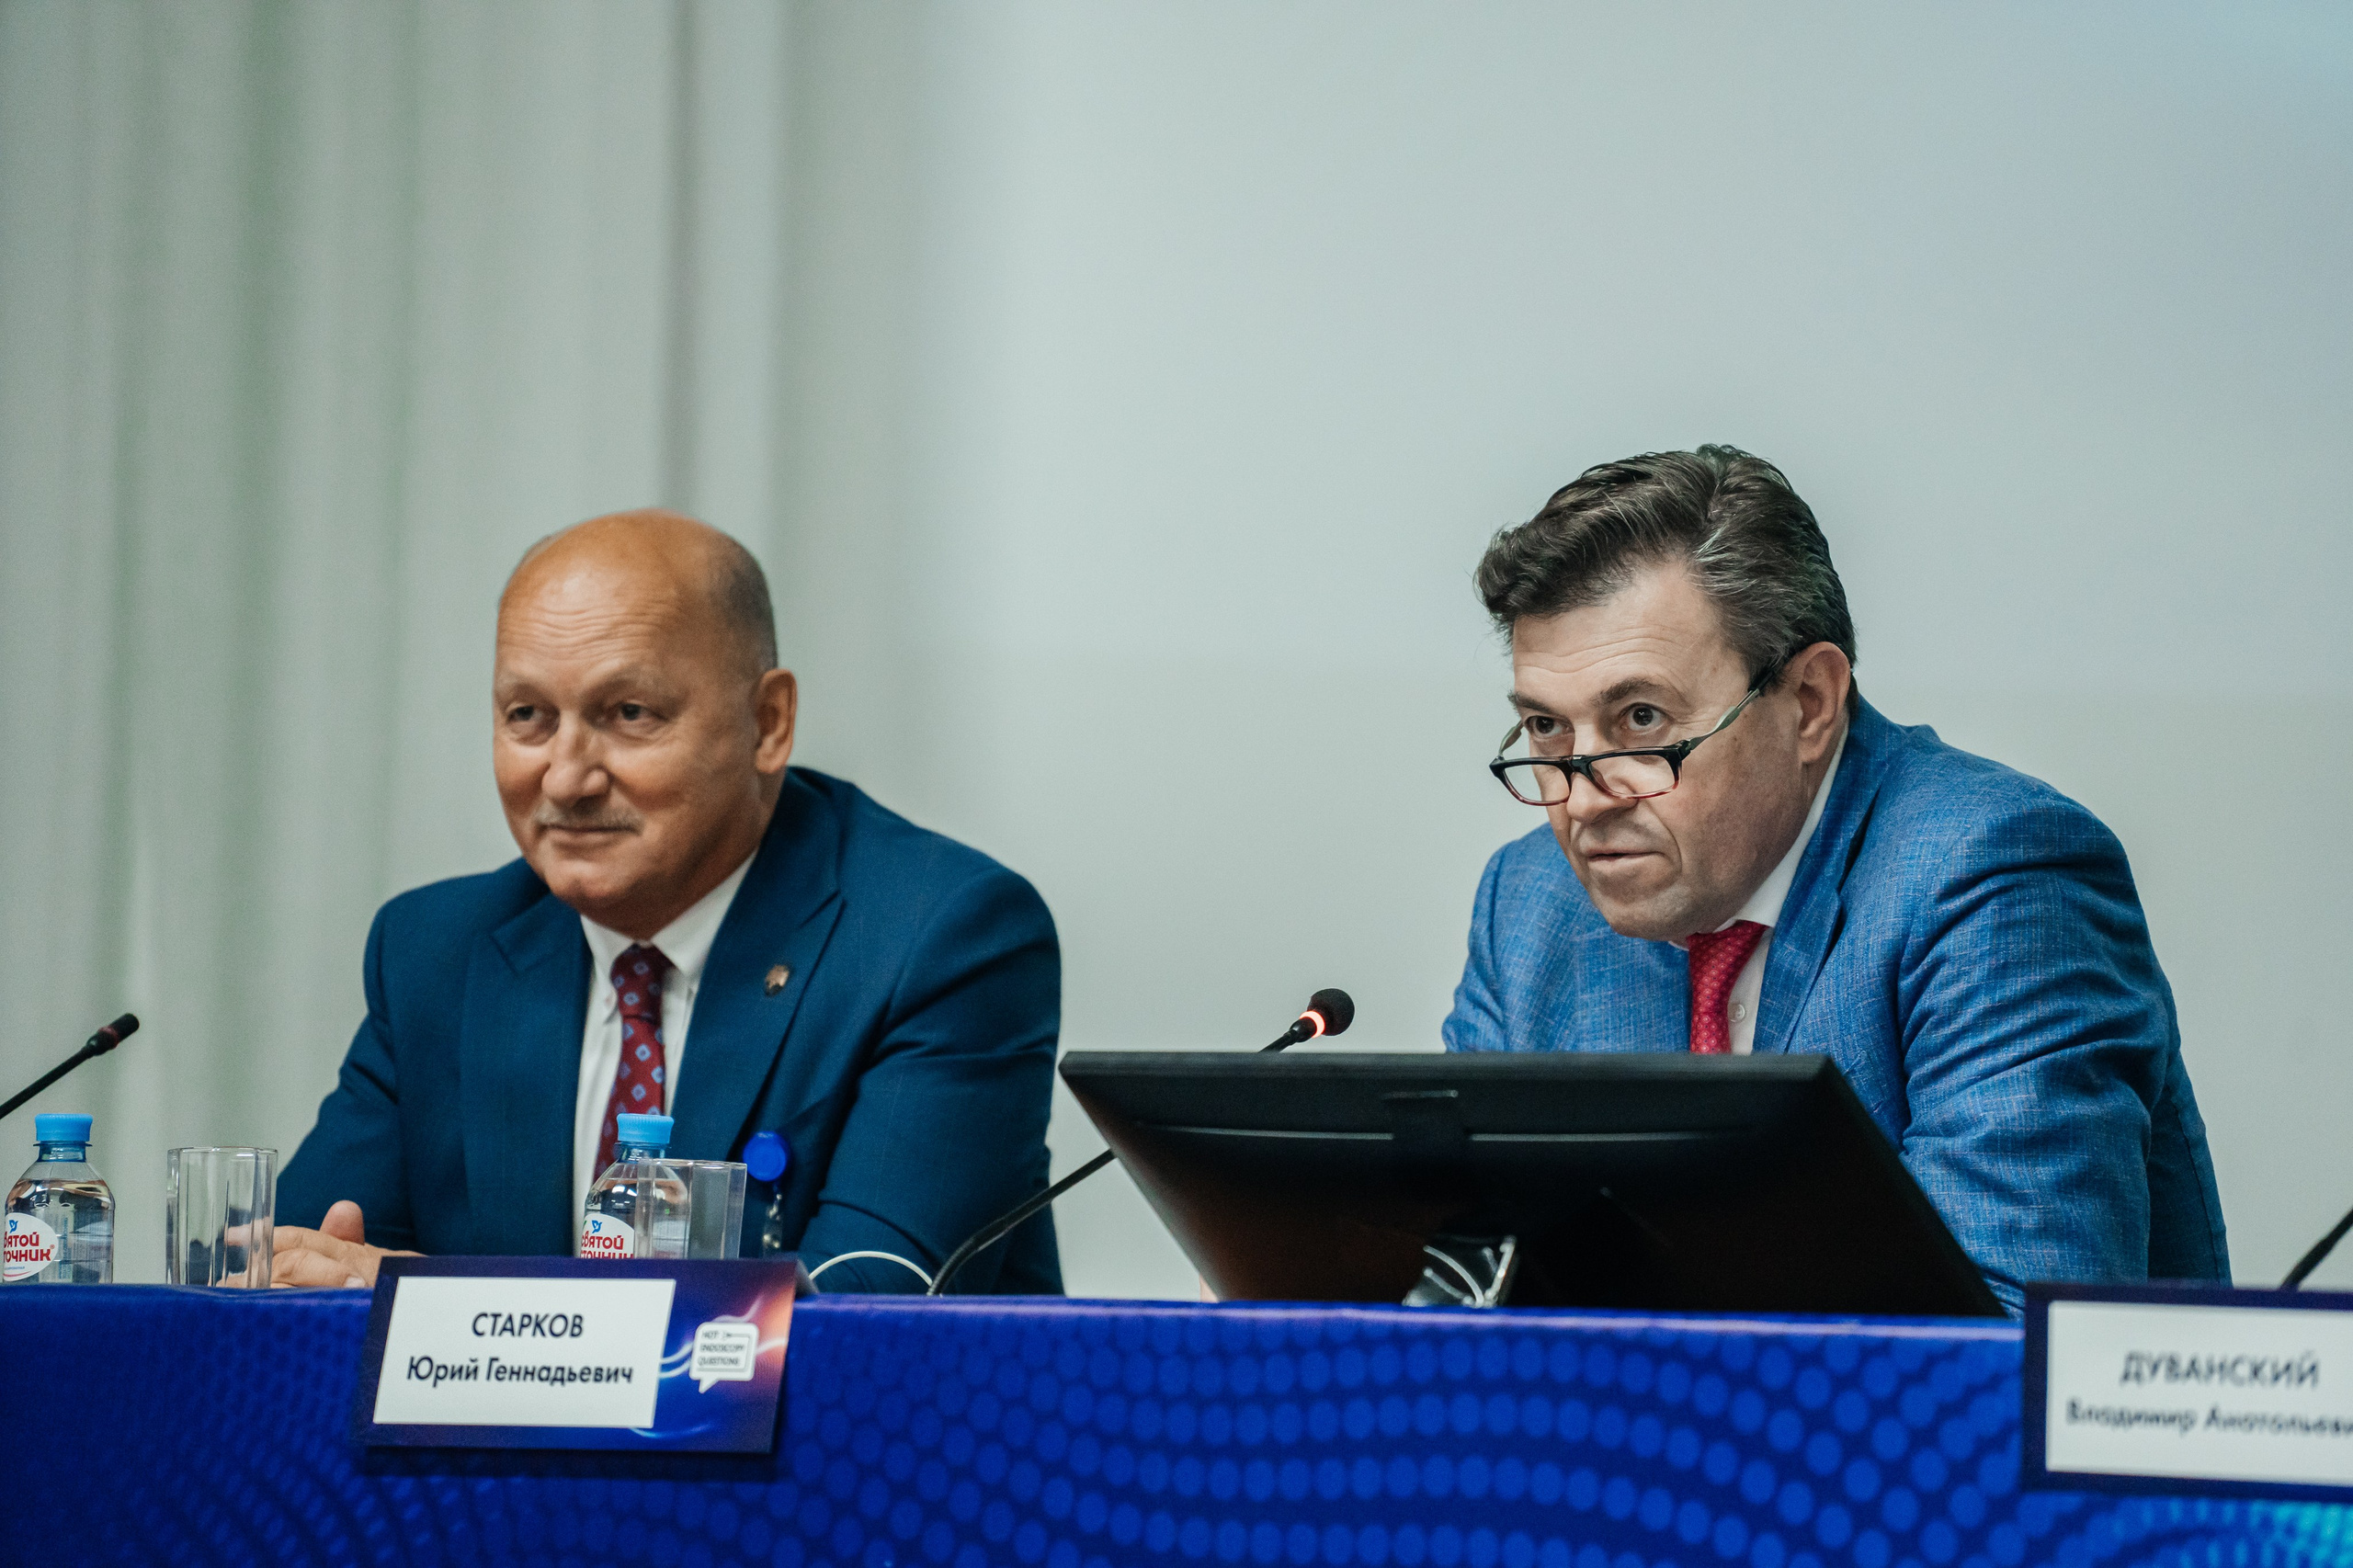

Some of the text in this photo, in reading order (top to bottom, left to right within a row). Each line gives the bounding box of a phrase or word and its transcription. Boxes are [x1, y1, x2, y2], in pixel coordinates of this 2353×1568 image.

[472, 1312, 585, 1338] СТАРКОВ
[406, 1356, 634, 1388] Юрий Геннадьевич
[2120, 1350, 2320, 1388] ДУВАНСКИЙ
[2066, 1399, 2197, 1437] Владимир
